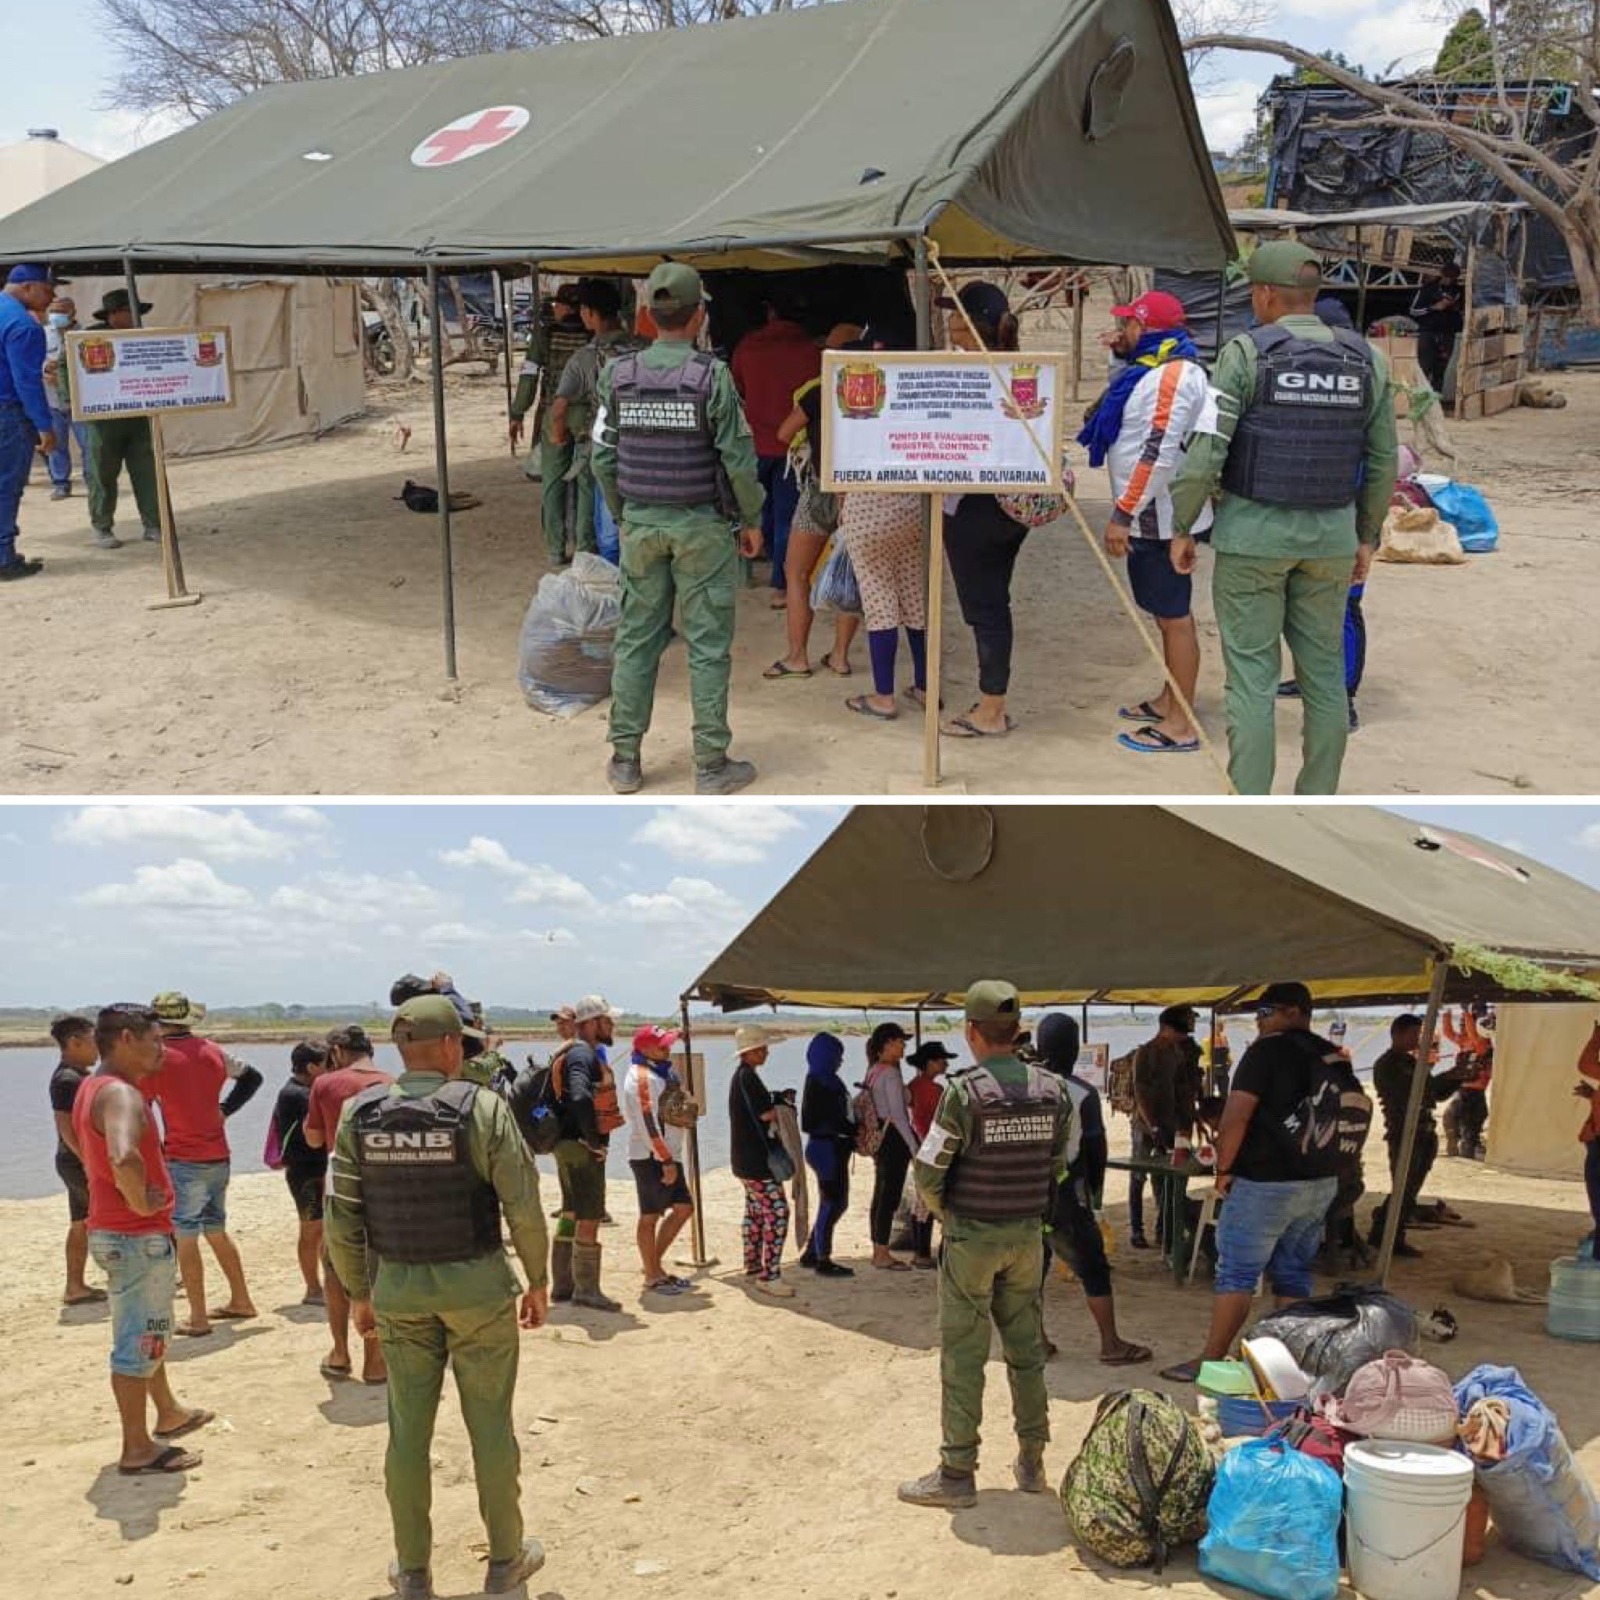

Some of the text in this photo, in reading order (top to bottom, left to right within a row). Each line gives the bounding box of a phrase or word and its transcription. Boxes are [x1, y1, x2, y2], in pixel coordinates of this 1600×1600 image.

[1277, 372, 1361, 391] GNB
[888, 432, 918, 441] PUNTO
[920, 432, 931, 440] DE
[938, 442, 979, 451] CONTROL
[833, 469, 1047, 484] FUERZA ARMADA NACIONAL BOLIVARIANA
[364, 1132, 452, 1148] GNB
